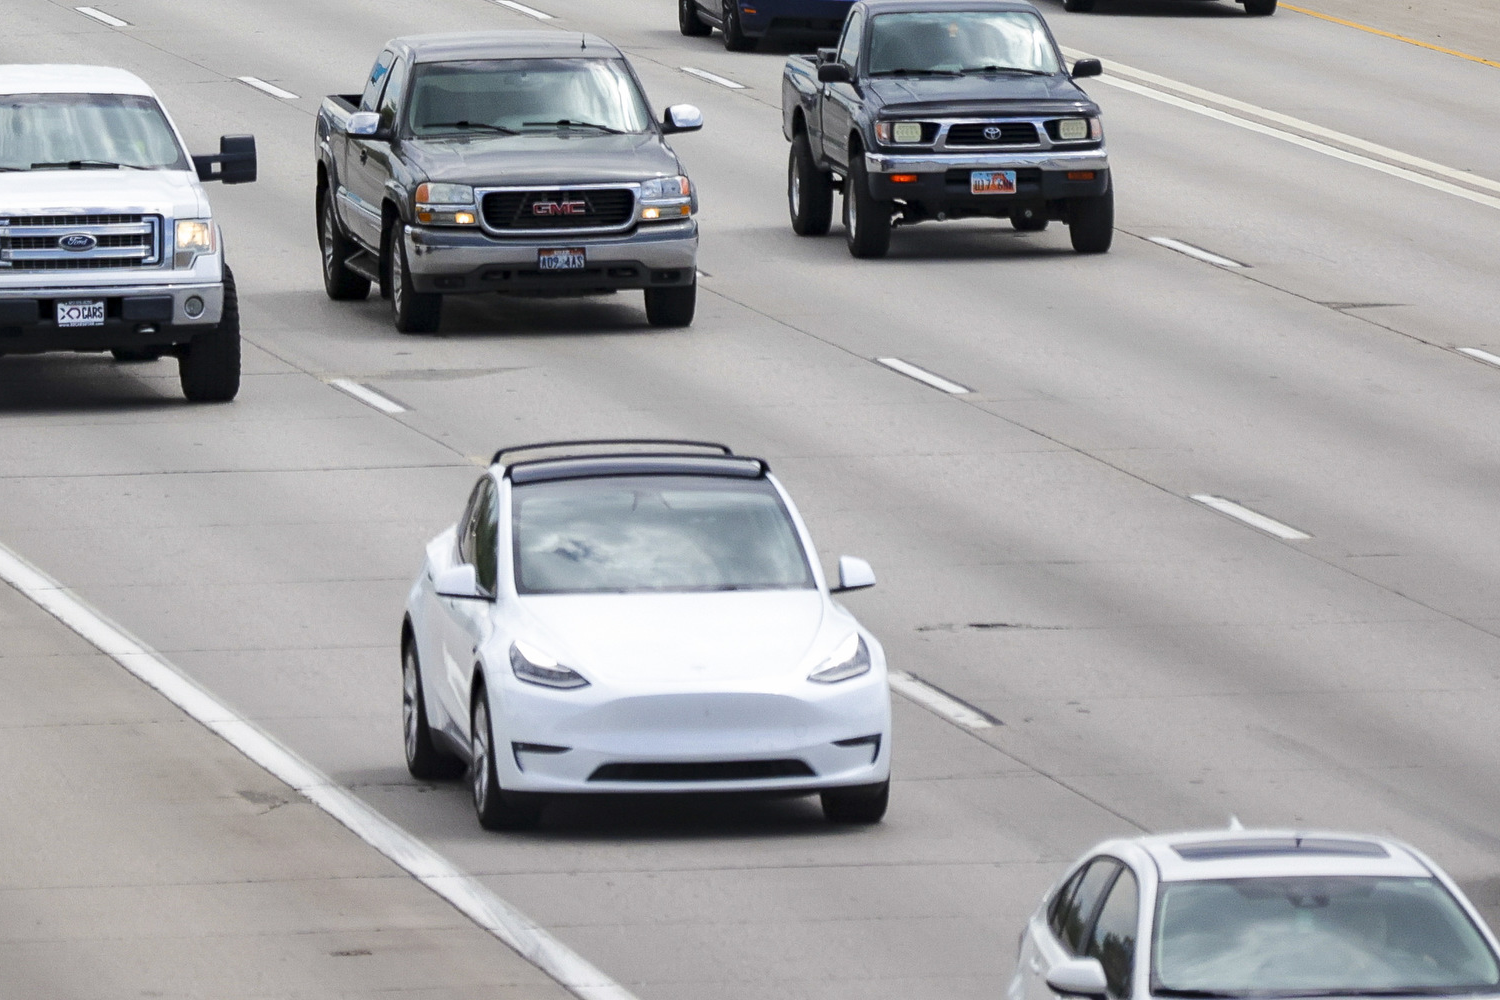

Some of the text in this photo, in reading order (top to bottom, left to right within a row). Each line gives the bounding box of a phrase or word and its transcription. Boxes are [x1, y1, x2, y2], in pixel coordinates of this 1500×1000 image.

[533, 202, 583, 215] GMC
[67, 235, 88, 246] Ford
[81, 306, 103, 320] CARS
